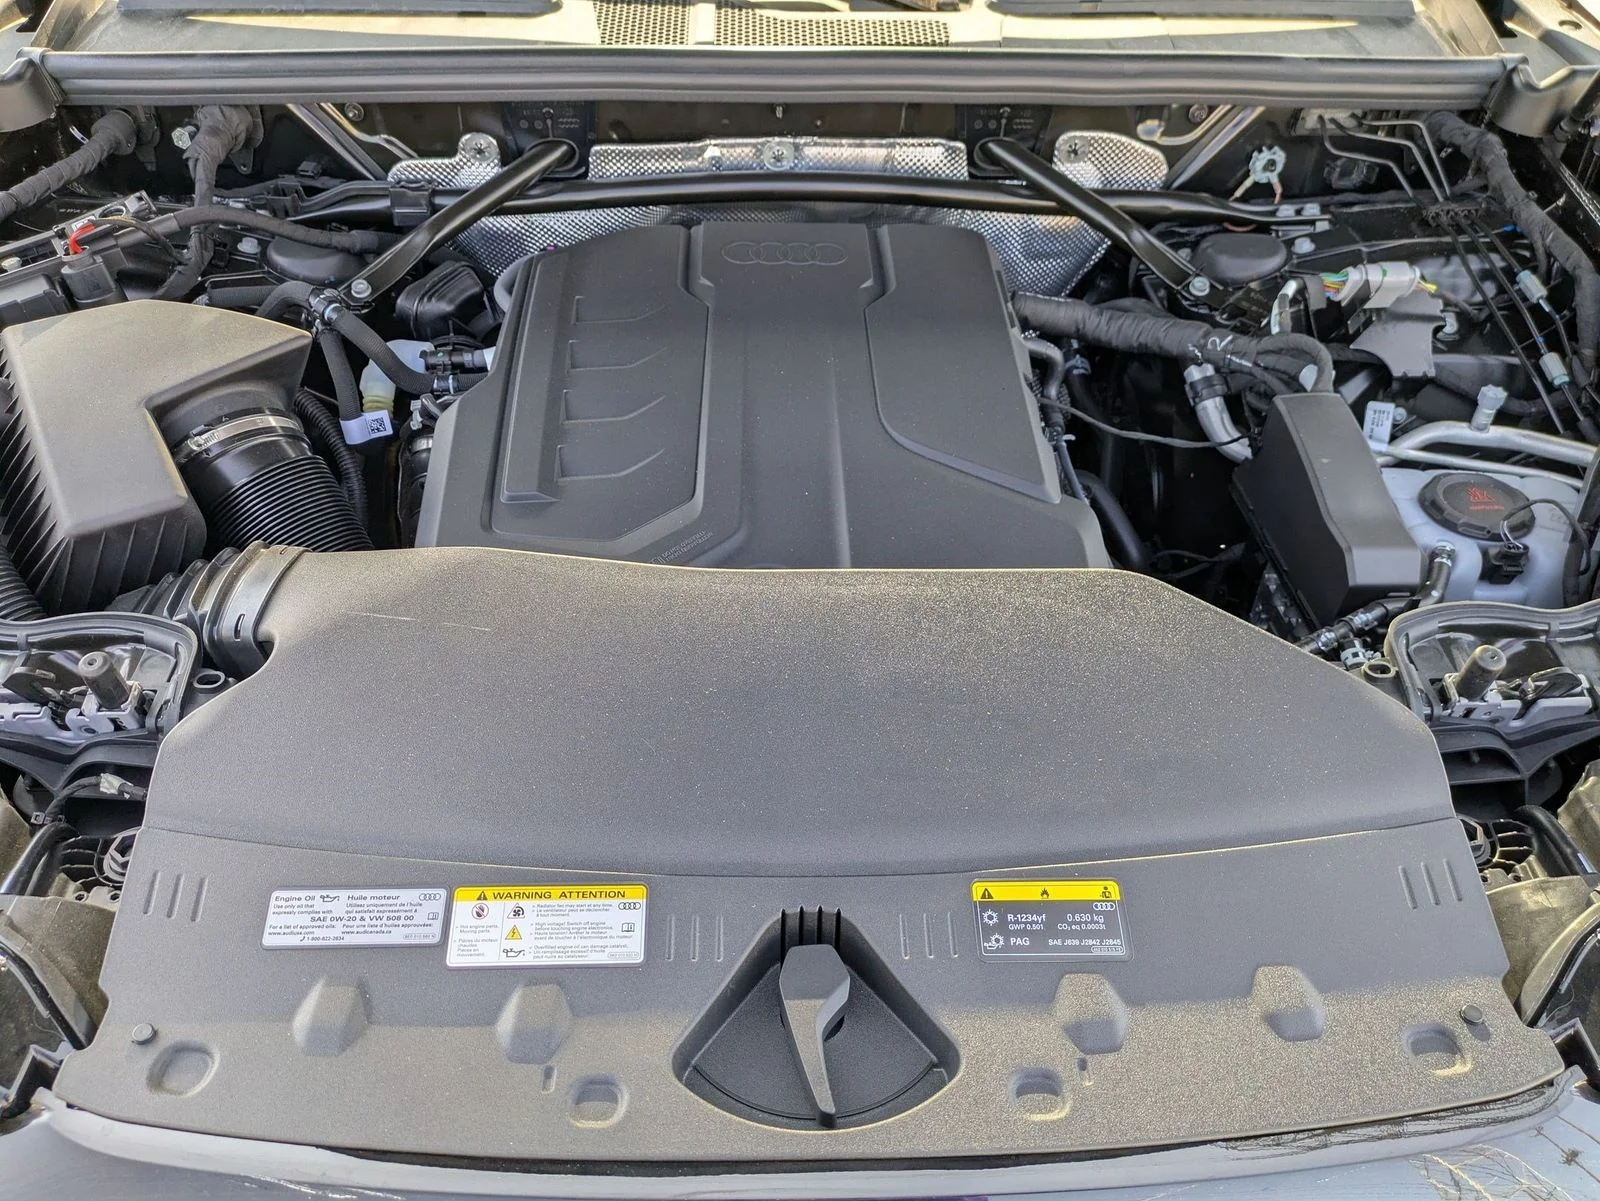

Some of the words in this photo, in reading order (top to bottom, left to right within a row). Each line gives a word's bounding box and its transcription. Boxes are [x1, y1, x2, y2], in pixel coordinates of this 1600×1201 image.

[492, 891, 552, 899] WARNING
[558, 890, 626, 899] ATTENTION
[1007, 914, 1046, 923] R-1234yf
[1067, 914, 1091, 922] 0.630
[1094, 914, 1104, 923] kg
[1010, 937, 1030, 946] PAG
